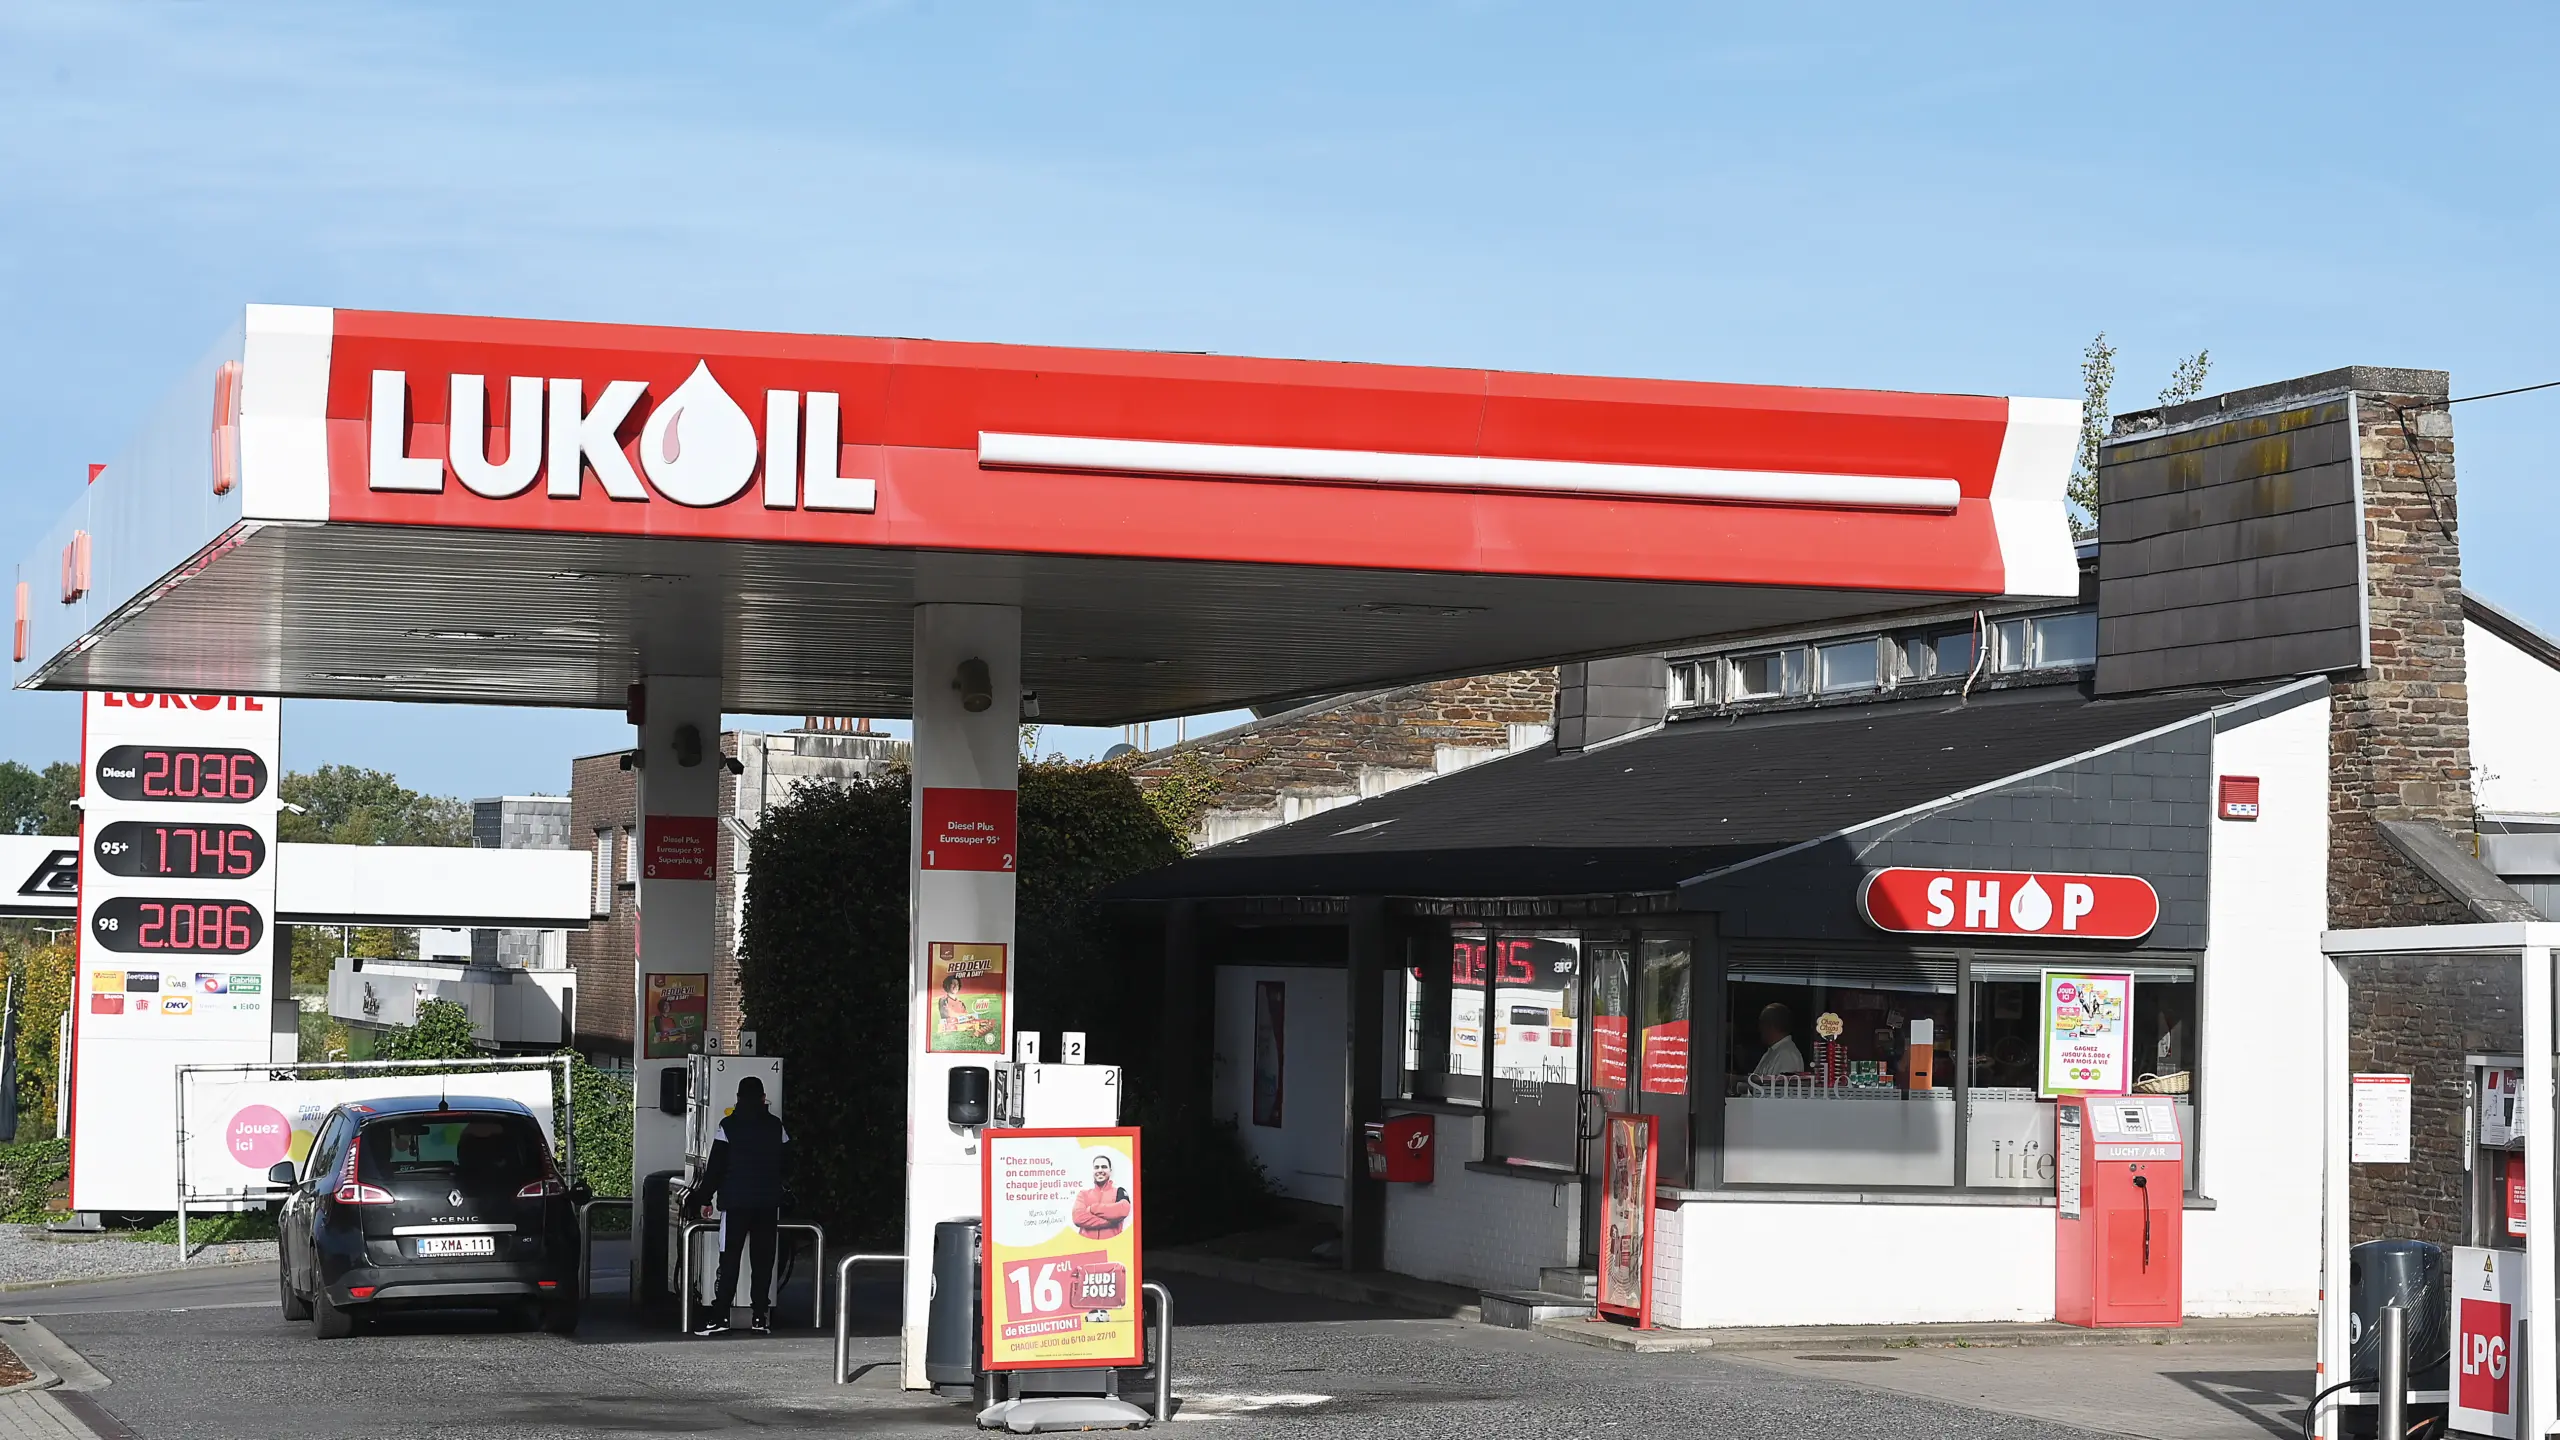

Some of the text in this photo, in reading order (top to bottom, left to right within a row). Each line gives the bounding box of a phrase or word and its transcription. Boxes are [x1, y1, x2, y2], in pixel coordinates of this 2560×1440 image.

[368, 359, 877, 512] LUKOIL
[102, 752, 255, 799] Diesel 2.036
[947, 821, 995, 831] Diesel Plus
[662, 835, 700, 844] Diesel Plus
[940, 834, 1001, 845] Eurosuper 95+
[100, 828, 253, 874] 95+ 1.745
[656, 846, 691, 855] Eurosuper
[658, 856, 703, 865] Superplus 98
[927, 850, 1013, 869] 1 2
[647, 864, 714, 878] 3 4
[1926, 874, 2095, 931] SHOP
[98, 903, 251, 950] 98 2.086
[948, 959, 993, 973] RED DEVIL
[2058, 987, 2075, 995] JOUEZ
[975, 1002, 989, 1010] WIN
[1819, 1024, 1840, 1032] Chups
[709, 1037, 718, 1049] 3
[744, 1038, 753, 1050] 4
[1026, 1041, 1034, 1055] 1
[1071, 1042, 1081, 1056] 2
[716, 1059, 780, 1074] 3 4
[1542, 1054, 1567, 1084] fresh
[1033, 1068, 1116, 1086] 1 2
[1747, 1062, 1855, 1100] smile
[2506, 1076, 2516, 1088] Lpg
[2465, 1080, 2473, 1099] 5
[298, 1105, 321, 1113] Euro
[235, 1122, 279, 1135] Jouez
[235, 1138, 253, 1151] ici
[2110, 1147, 2140, 1156] LUCHT
[2149, 1147, 2166, 1156] AIR
[1029, 1157, 1054, 1167] nous,
[1988, 1140, 2055, 1180] life
[1005, 1168, 1066, 1178] on commence
[1005, 1179, 1084, 1191] chaque jeudi avec
[1005, 1192, 1015, 1202] le
[1016, 1191, 1048, 1201] sourire
[427, 1239, 492, 1252] 1-XMA-111
[1082, 1271, 1116, 1286] JEUDI
[1008, 1260, 1073, 1314] 16 ct/l
[1082, 1284, 1116, 1298] FOUS
[1005, 1326, 1017, 1337] de
[1017, 1320, 1073, 1335] REDUCTION
[1010, 1331, 1117, 1352] CHAQUE JEUDI du 6/10 au 27/10
[2462, 1332, 2507, 1380] LPG
